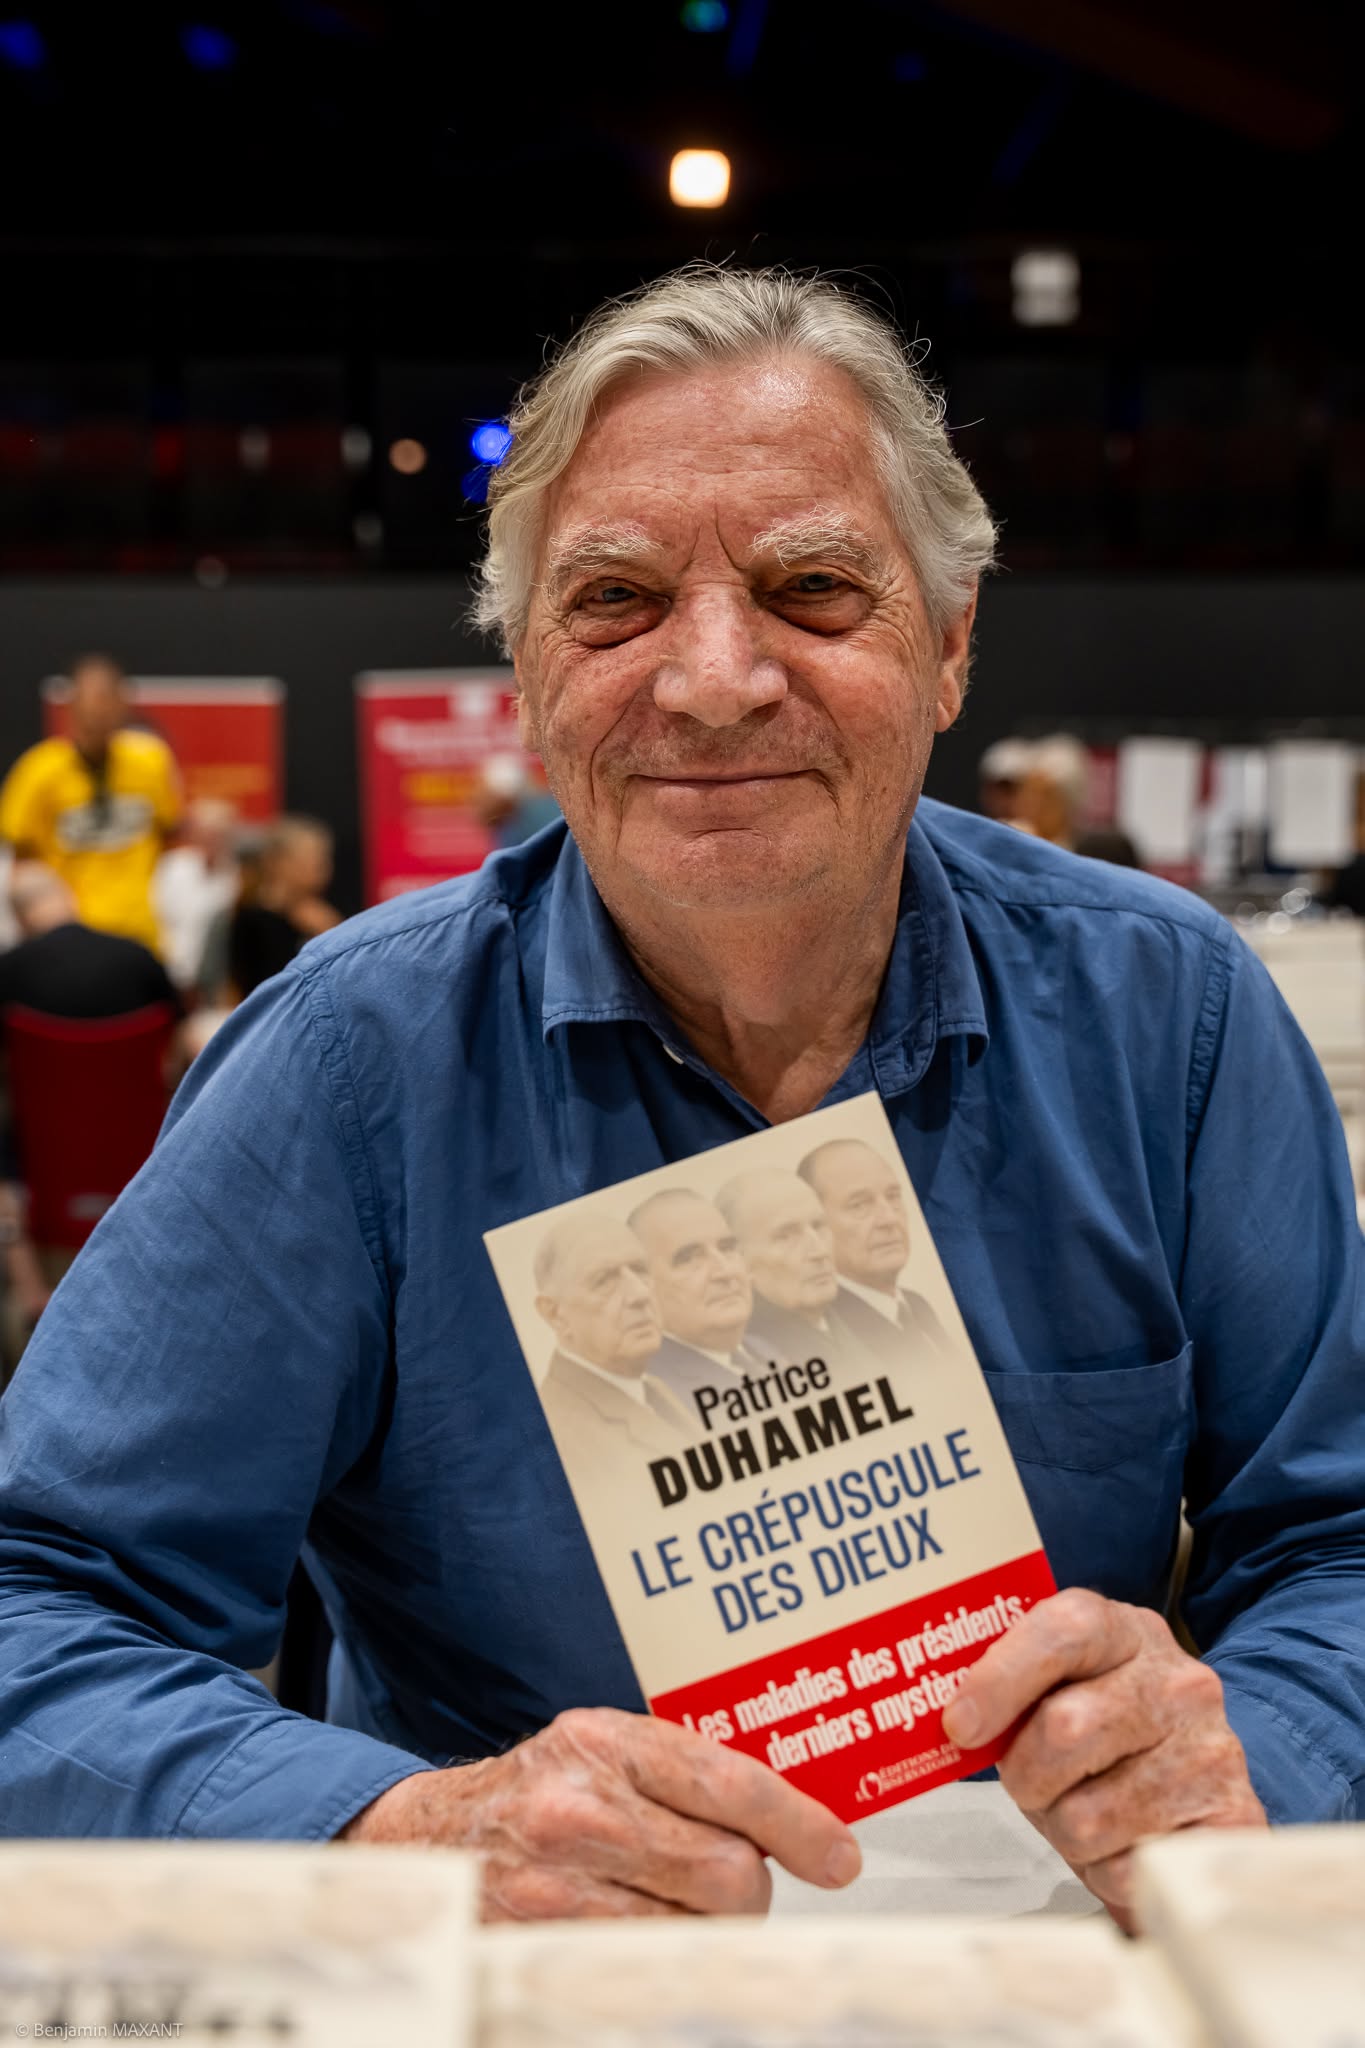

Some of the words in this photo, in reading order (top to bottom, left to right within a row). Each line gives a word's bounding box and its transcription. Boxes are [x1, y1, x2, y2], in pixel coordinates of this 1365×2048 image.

[648, 1376, 914, 1508] DUHAMEL
[693, 1357, 831, 1431] Patrice
[631, 1536, 693, 1598] LE
[698, 1428, 981, 1572] CRÉPUSCULE
[711, 1561, 804, 1634] DES
[809, 1508, 944, 1598] DIEUX
[733, 1666, 848, 1734] maladies
[847, 1647, 898, 1690] des
[896, 1593, 1025, 1679] présidents
[766, 1707, 873, 1773] derniers
